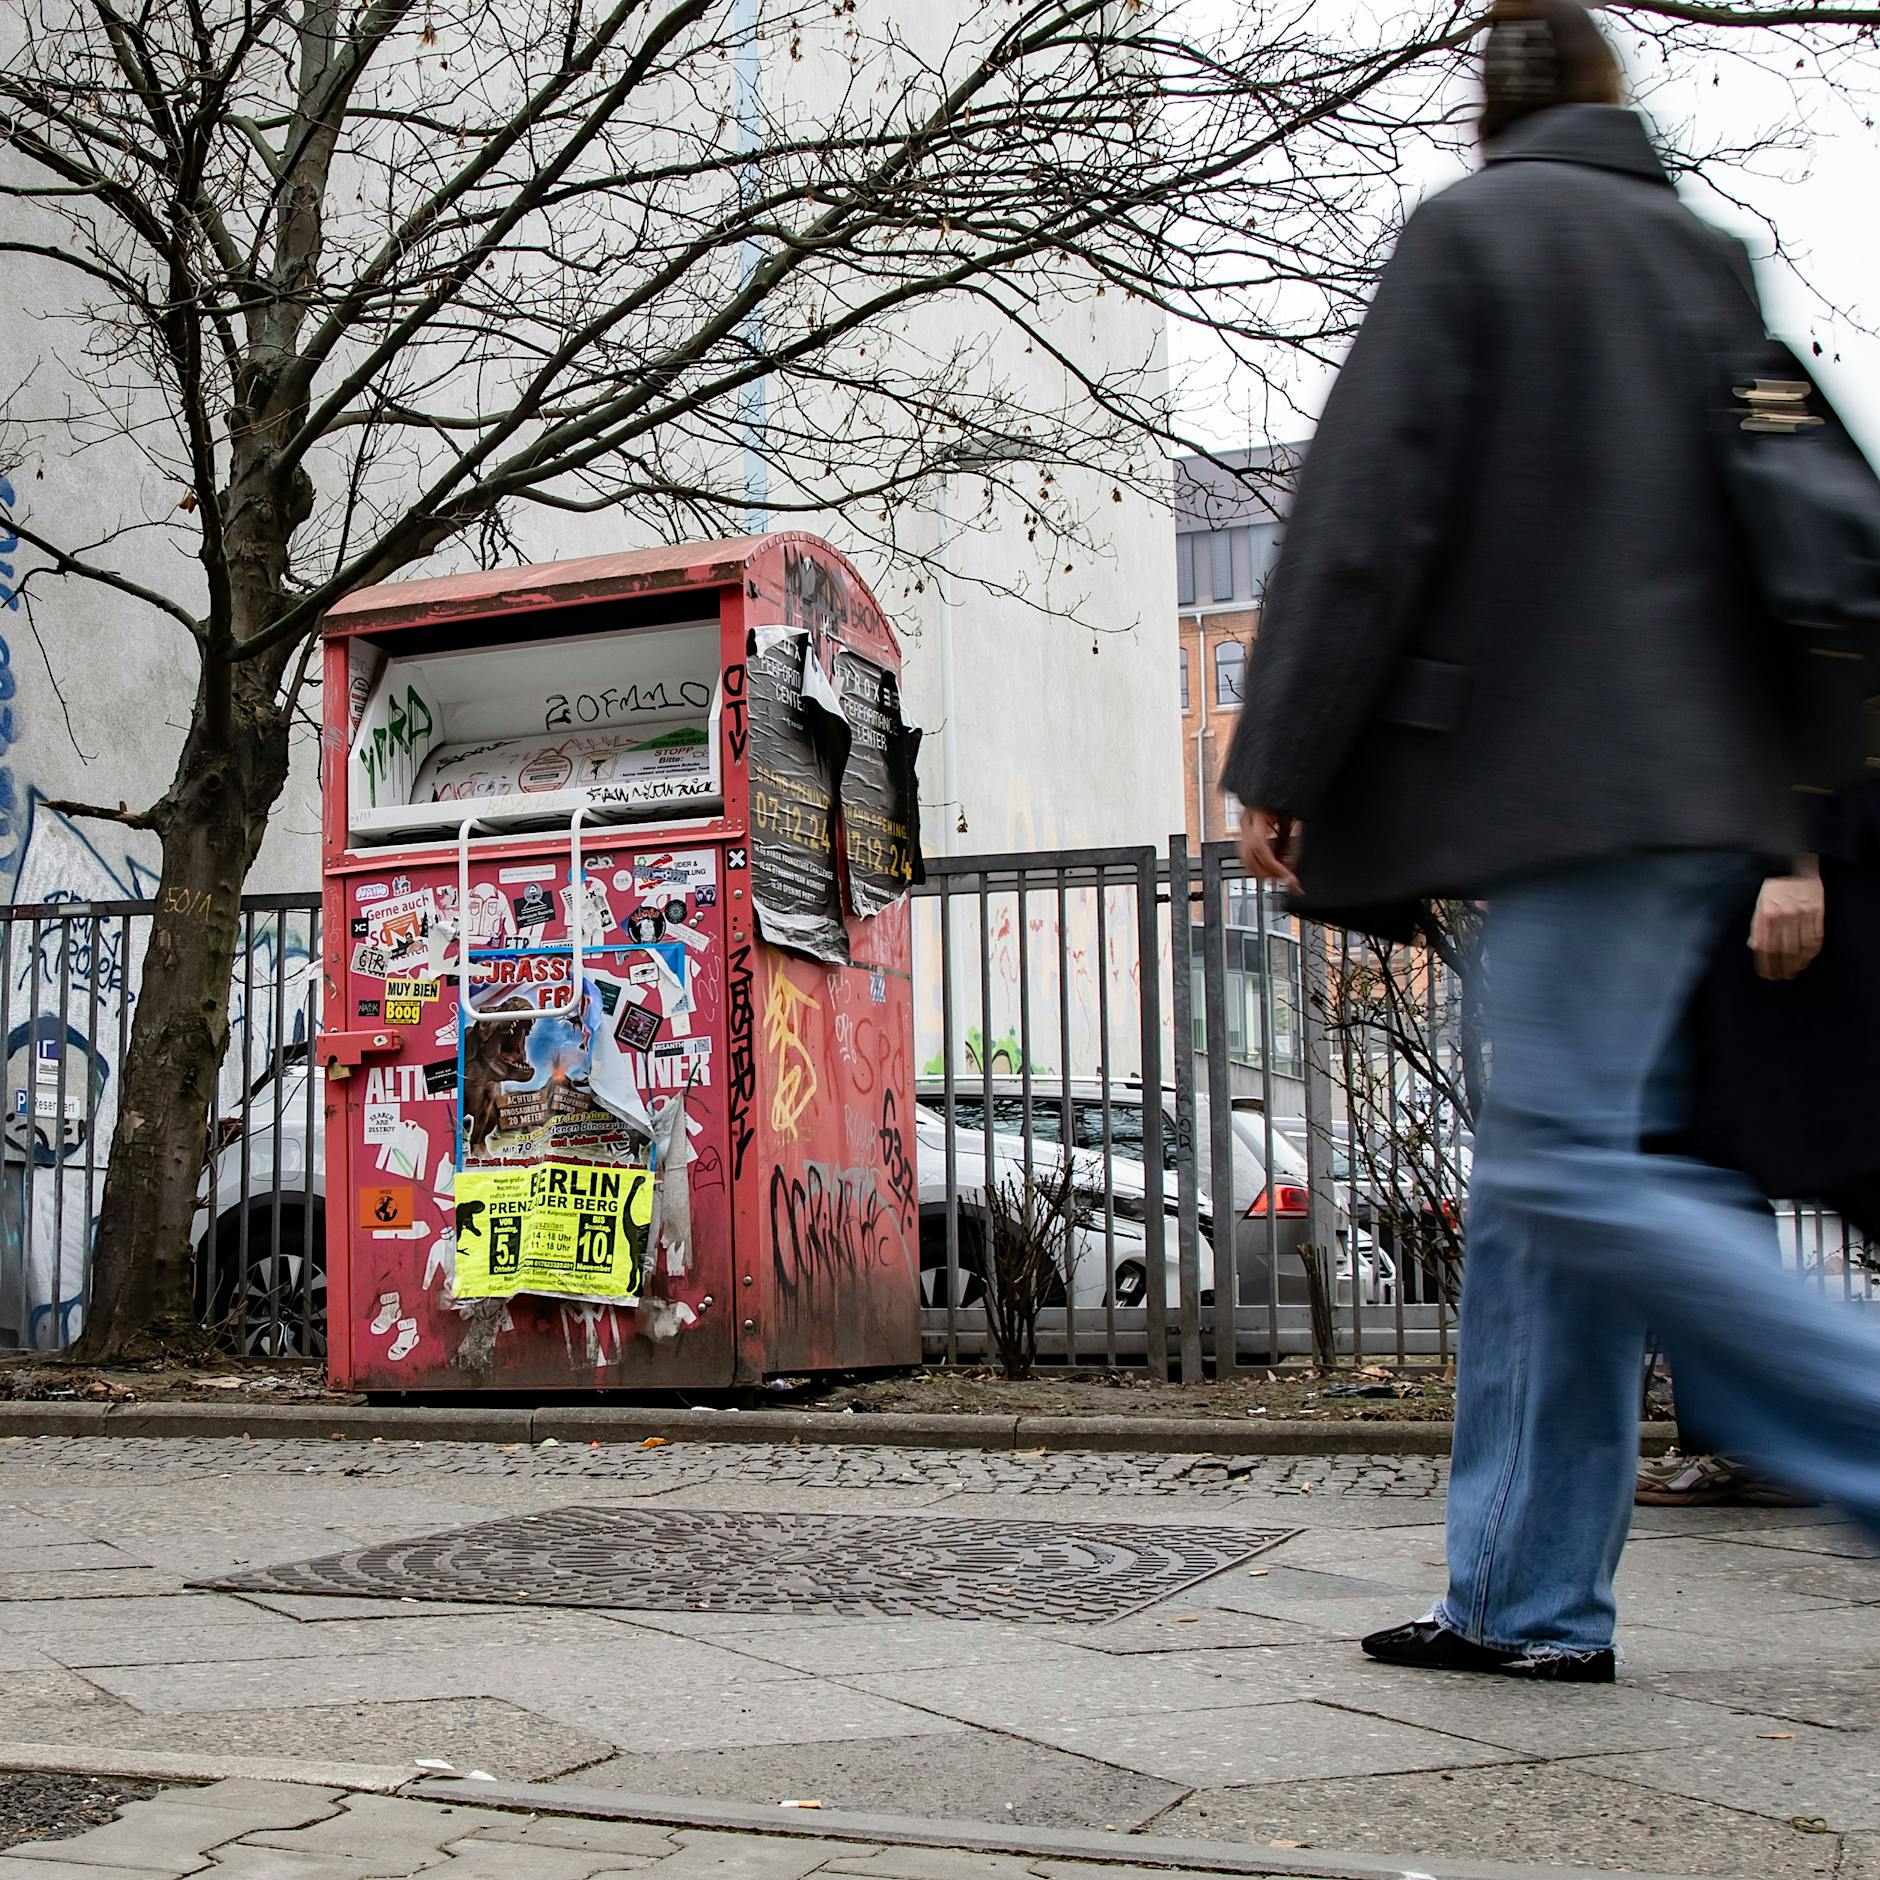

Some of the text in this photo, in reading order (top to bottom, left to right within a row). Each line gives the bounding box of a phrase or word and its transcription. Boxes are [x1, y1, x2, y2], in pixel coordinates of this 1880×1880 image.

[654, 746, 694, 757] STOPP
[366, 894, 429, 921] Gerne auch
[388, 982, 438, 998] MUY BIEN
[386, 1001, 420, 1024] Boog
[17, 1091, 27, 1112] P
[369, 1112, 394, 1121] SEARCH
[507, 1116, 518, 1126] 20
[517, 1142, 532, 1155] 70
[531, 1168, 620, 1198] BERLIN
[574, 1198, 618, 1213] BERG
[499, 1217, 513, 1226] VON
[592, 1215, 606, 1224] BIS
[532, 1231, 541, 1239] 14
[548, 1232, 556, 1240] 18
[558, 1233, 572, 1242] Uhr
[496, 1233, 515, 1265] 5.
[546, 1242, 554, 1250] 18
[556, 1242, 570, 1251] Uhr
[579, 1231, 613, 1265] 10.
[576, 1262, 612, 1273] November
